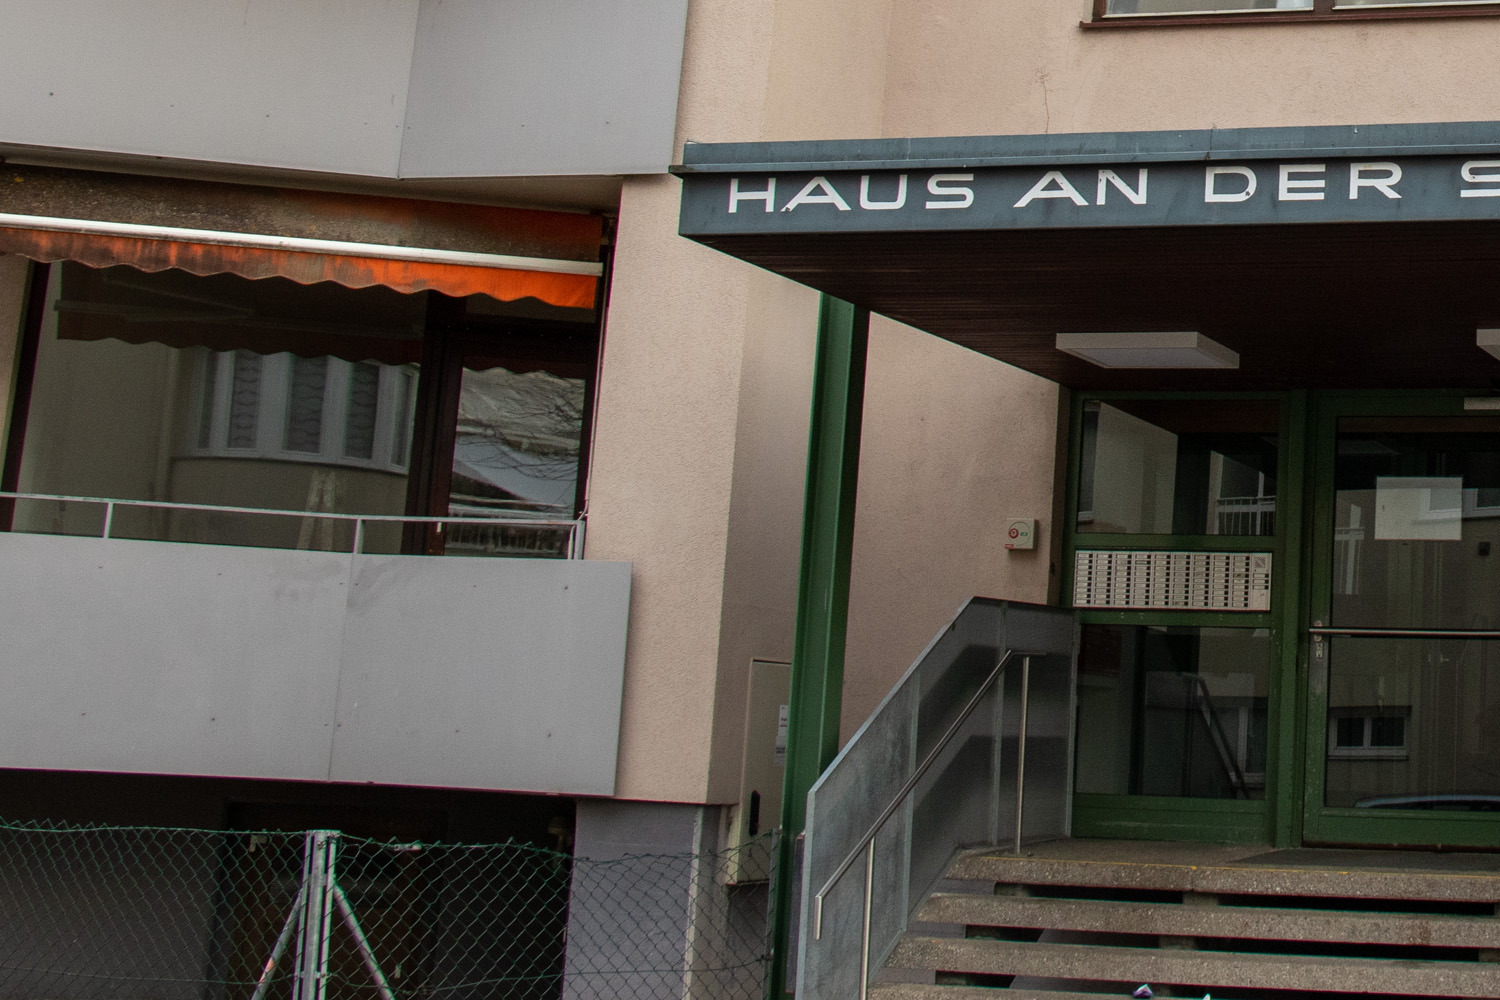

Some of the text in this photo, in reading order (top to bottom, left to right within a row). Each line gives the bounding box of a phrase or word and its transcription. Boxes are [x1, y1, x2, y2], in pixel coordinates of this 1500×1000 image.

[728, 173, 975, 213] HAUS
[1013, 168, 1149, 208] AN
[1204, 162, 1403, 203] DER
